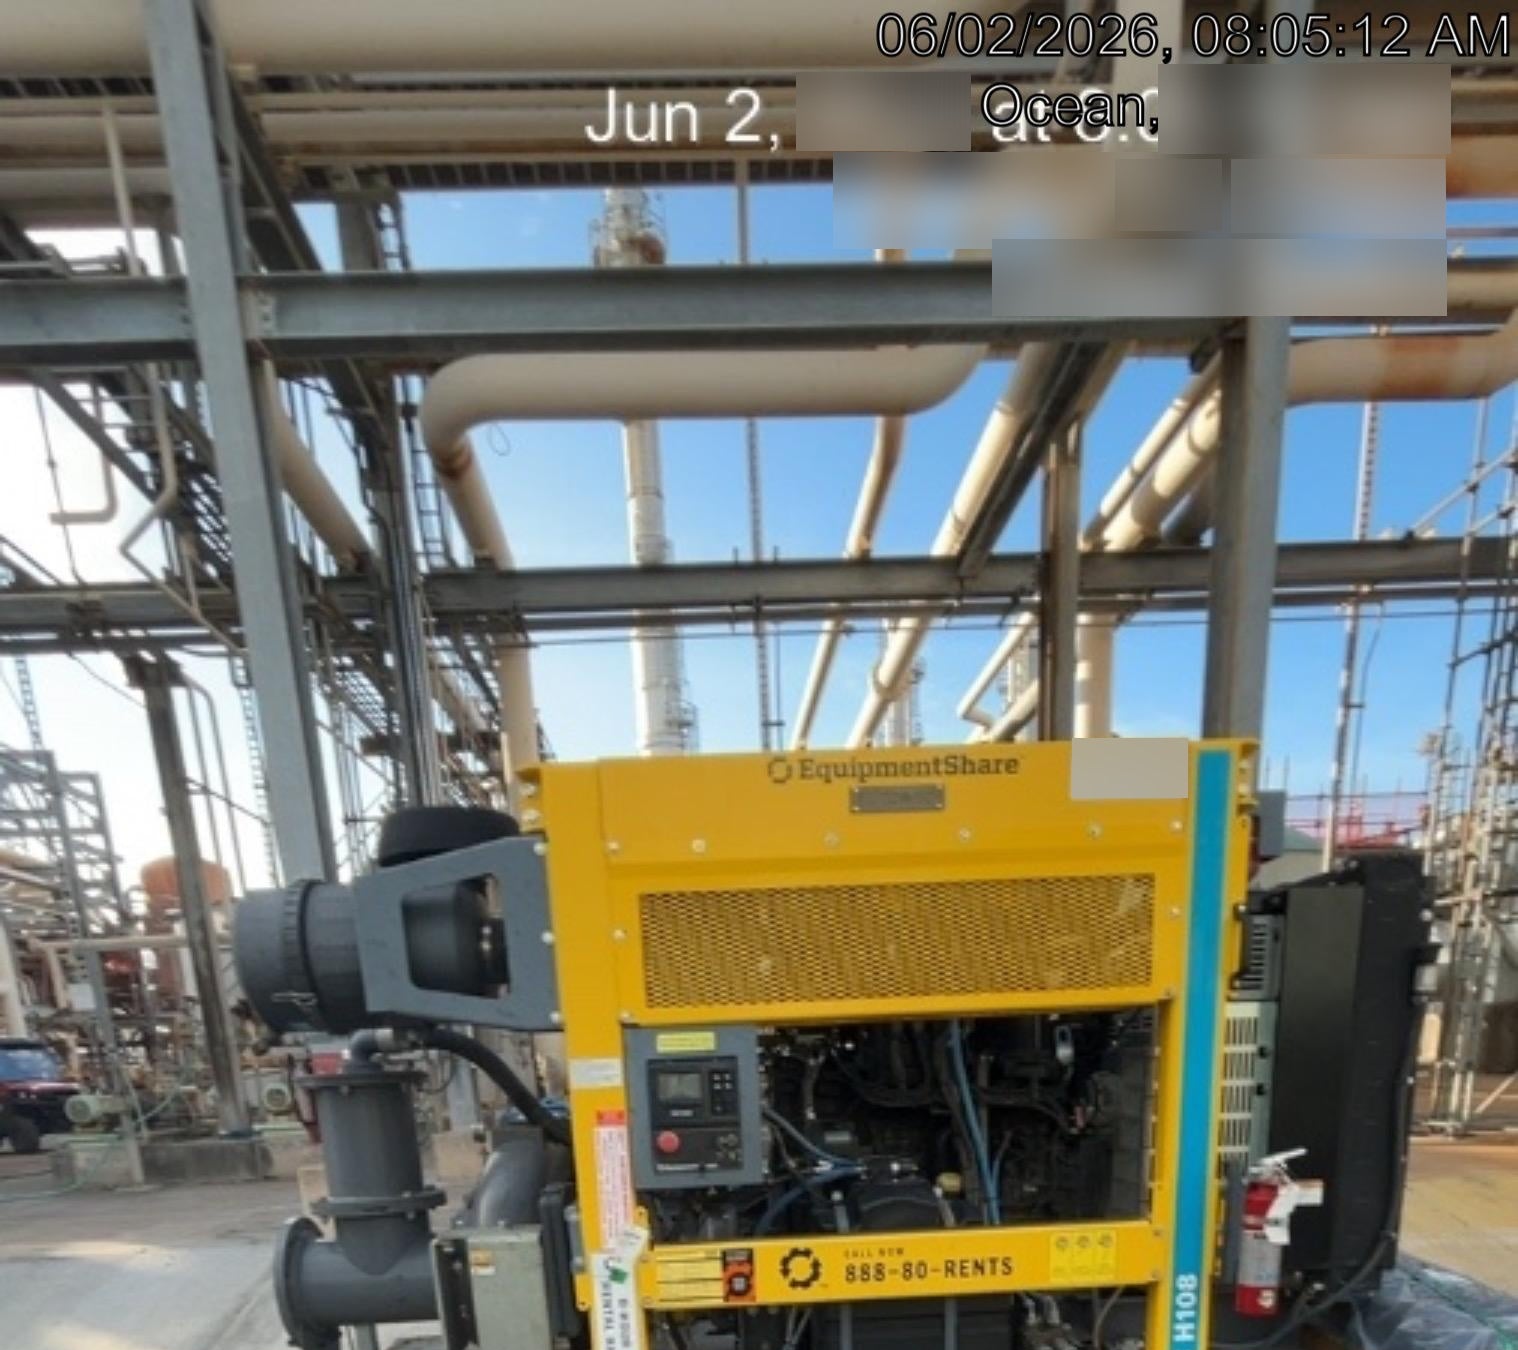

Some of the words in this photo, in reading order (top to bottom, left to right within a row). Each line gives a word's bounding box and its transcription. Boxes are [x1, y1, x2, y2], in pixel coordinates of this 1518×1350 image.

[798, 755, 1019, 783] EquipmentShare
[845, 1256, 1014, 1284] 888-80-RENTS
[1173, 1273, 1199, 1342] H108
